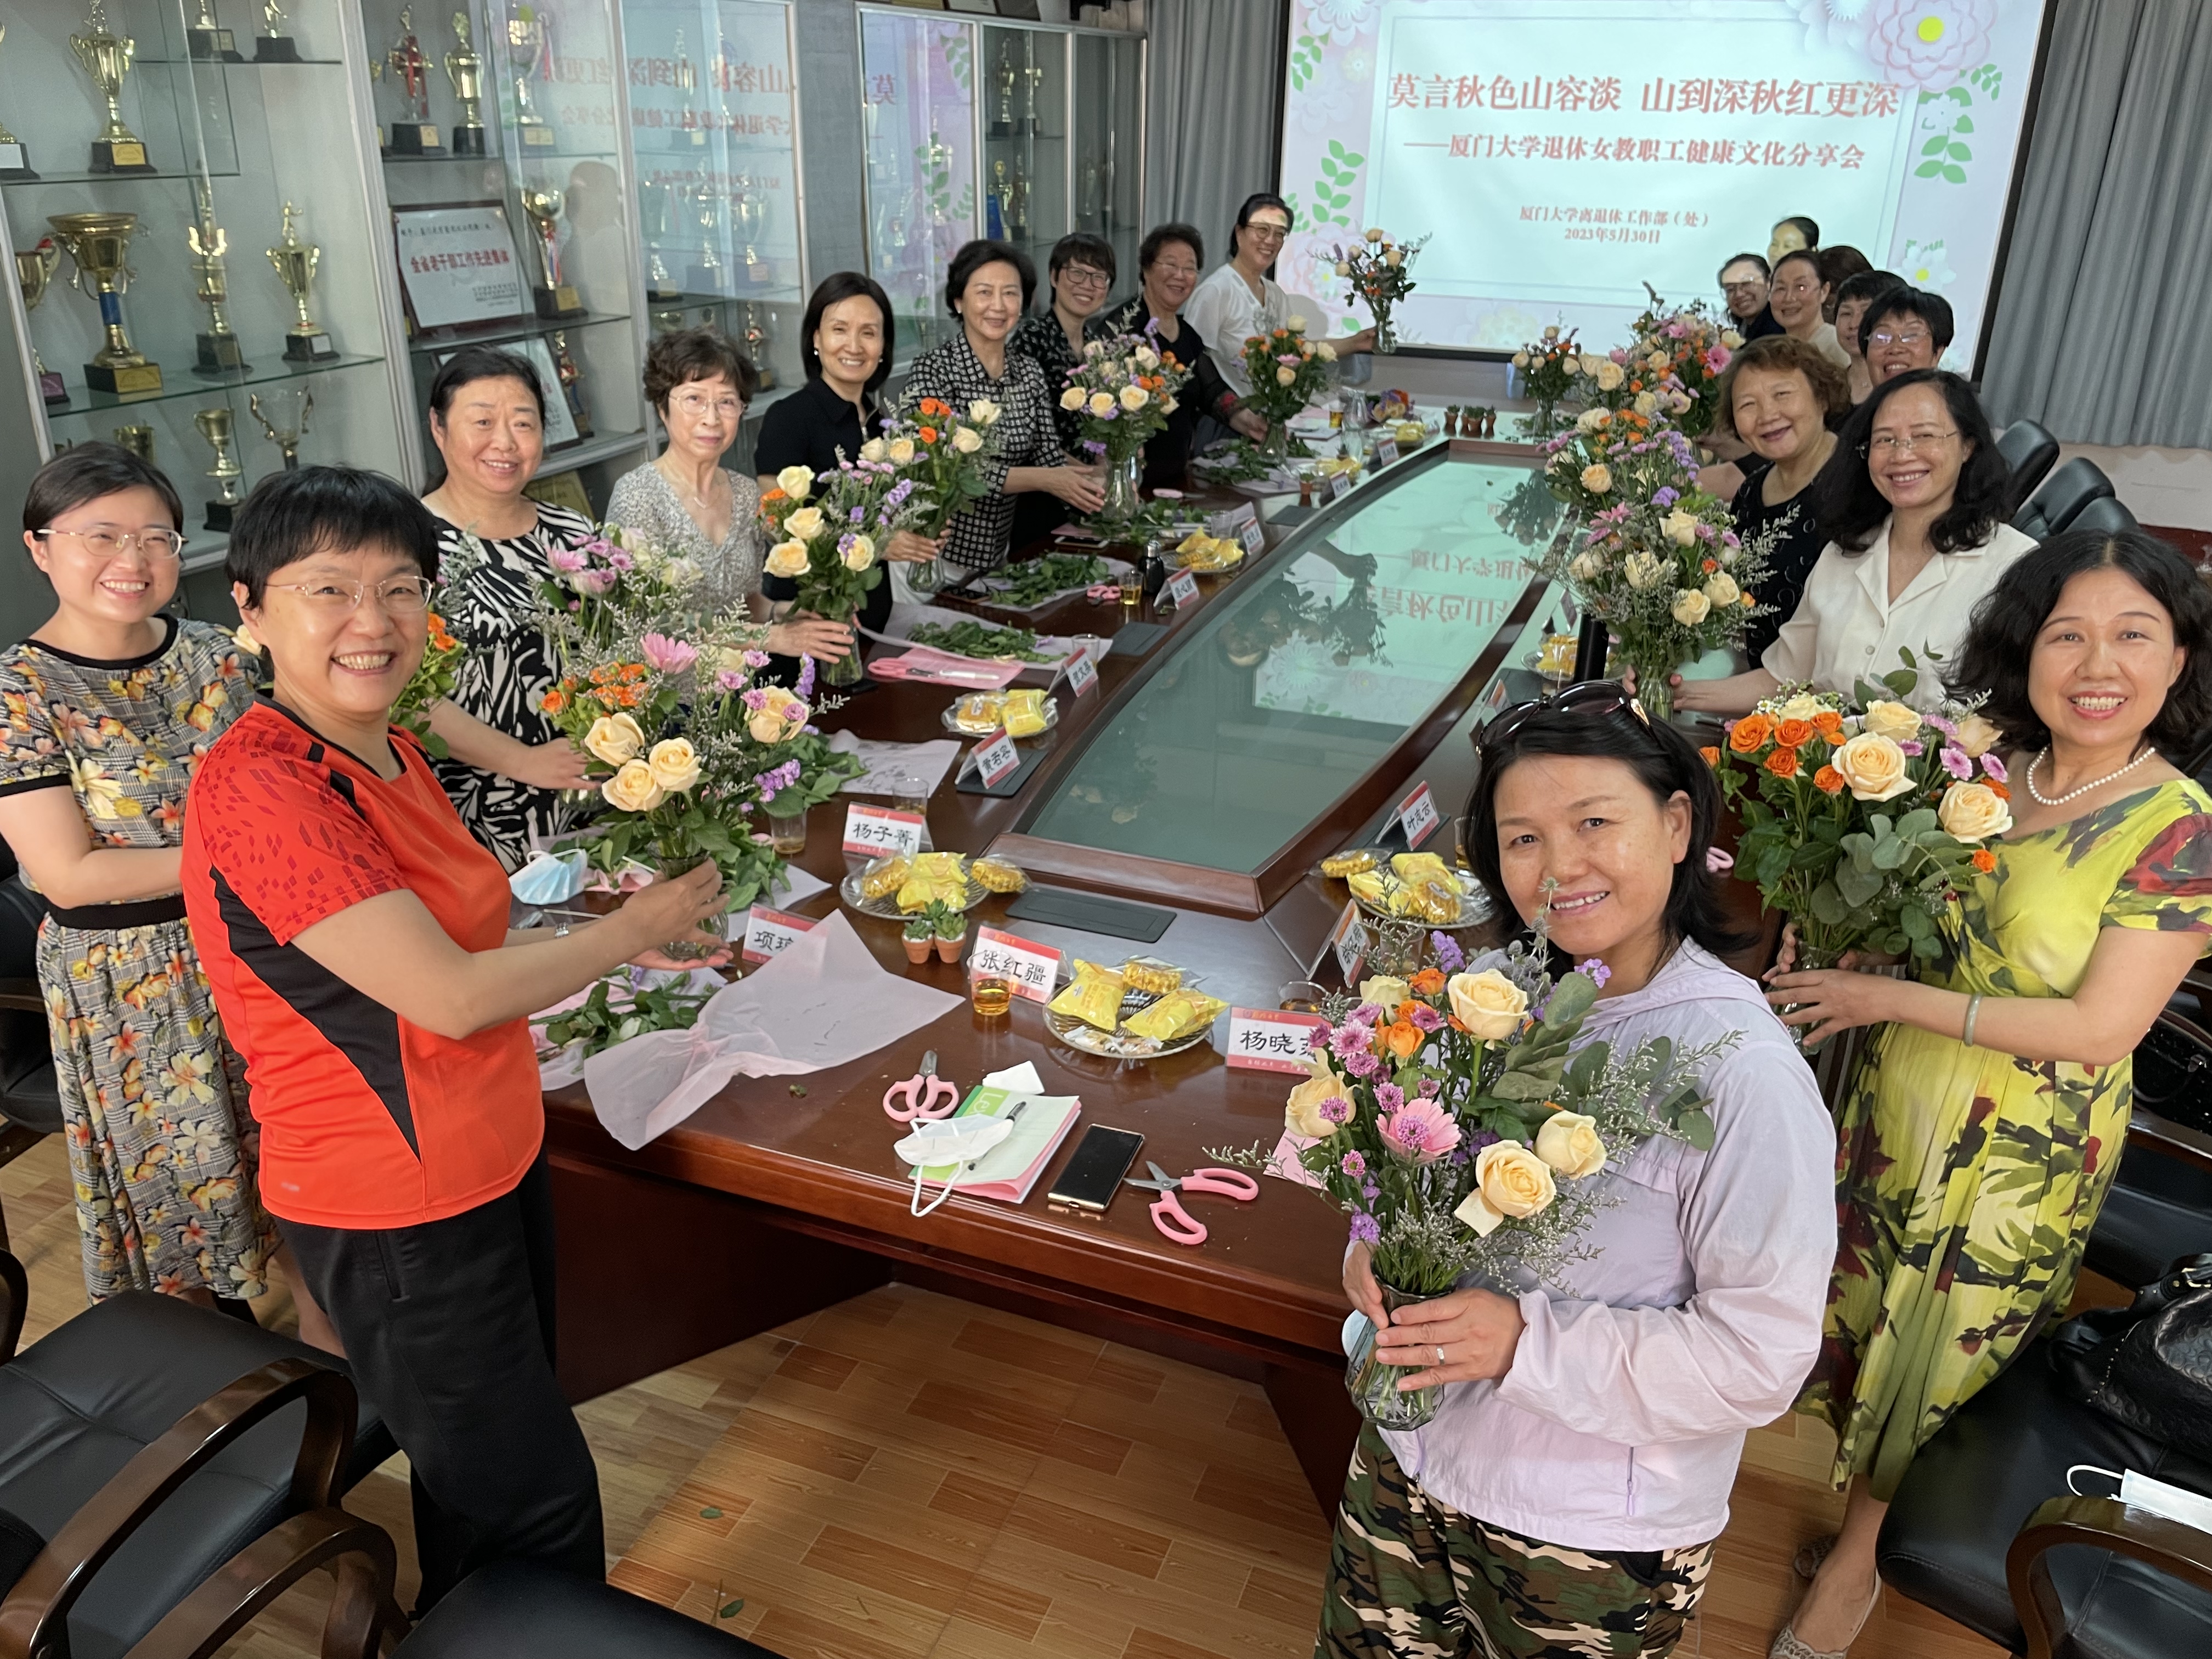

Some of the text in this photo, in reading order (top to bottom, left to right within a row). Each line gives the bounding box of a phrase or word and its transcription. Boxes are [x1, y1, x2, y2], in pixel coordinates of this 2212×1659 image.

[1388, 73, 1900, 117] 莫言秋色山容淡 山到深秋红更深
[1565, 227, 1660, 244] 2023年5月30日
[980, 950, 1046, 985] 张红疆
